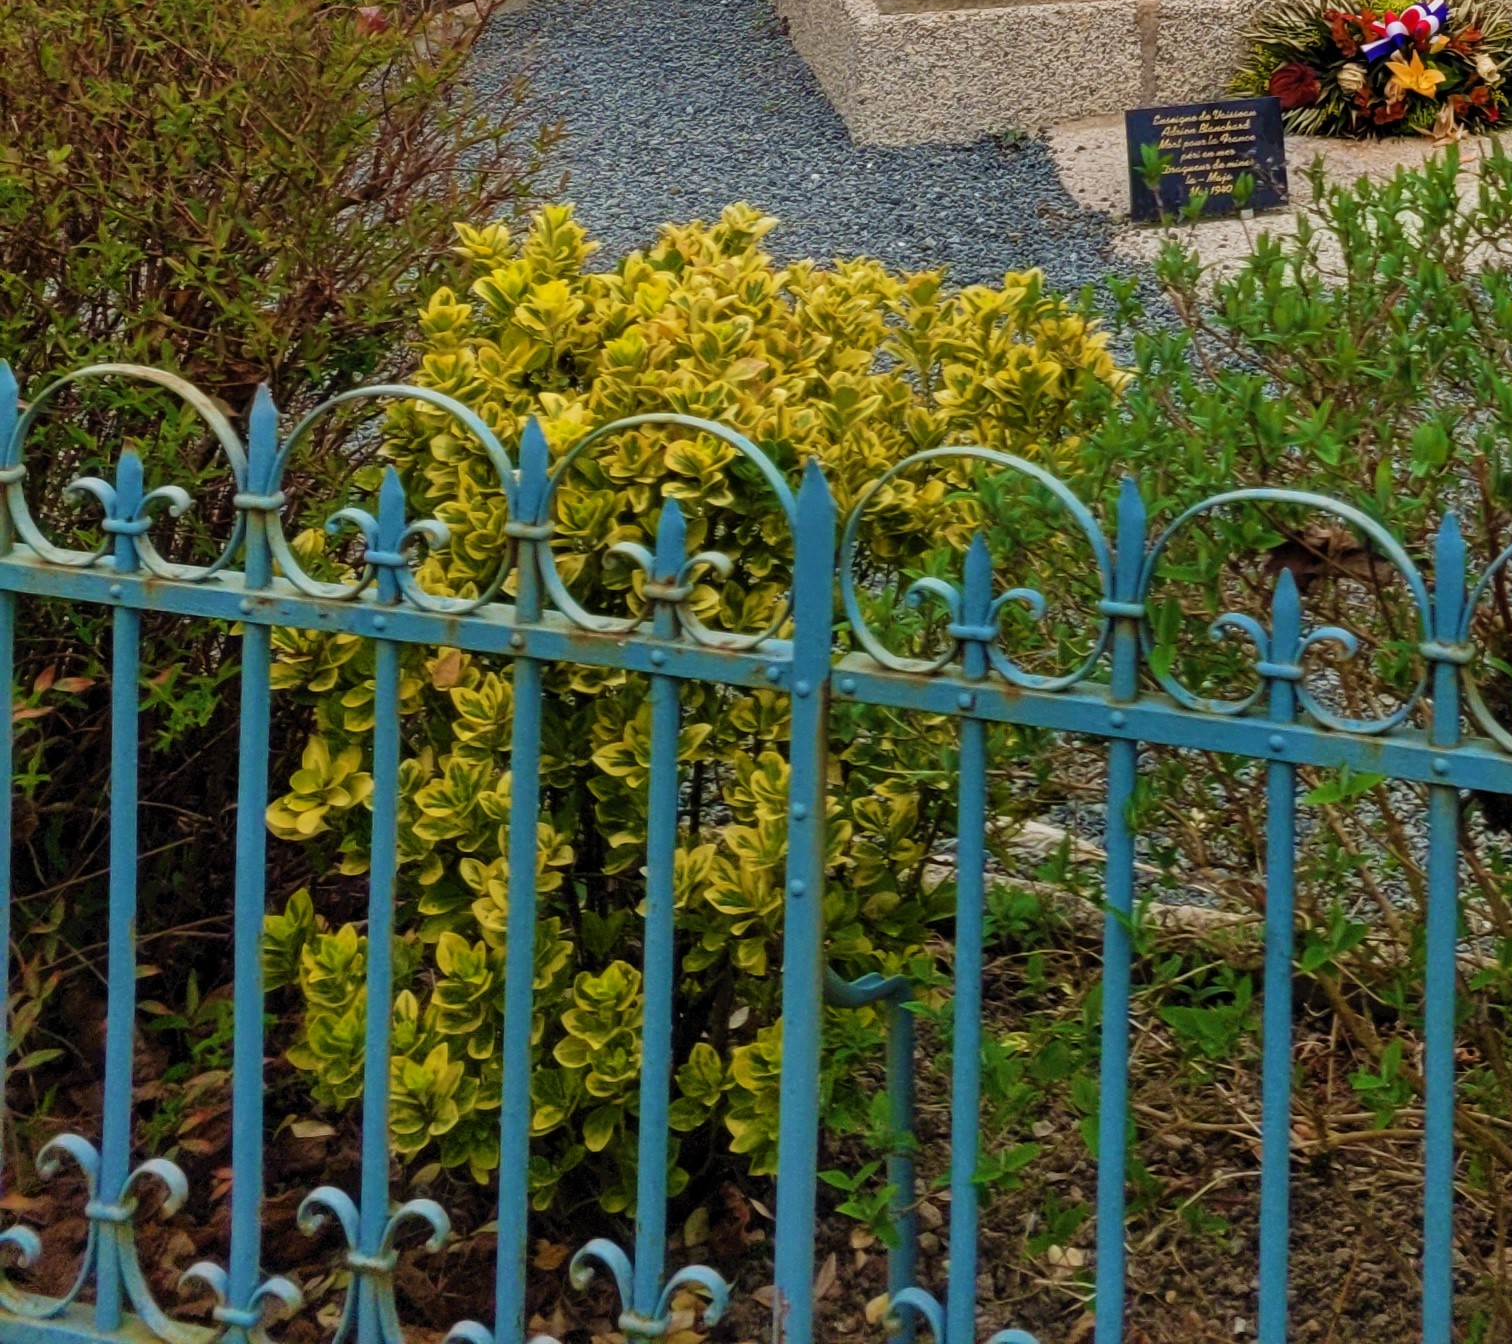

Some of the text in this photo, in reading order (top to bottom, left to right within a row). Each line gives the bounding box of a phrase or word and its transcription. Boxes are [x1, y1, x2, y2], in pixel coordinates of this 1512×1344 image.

[1198, 110, 1212, 121] de
[1198, 118, 1251, 134] Blanchard
[1158, 132, 1257, 151] Mort pour la France
